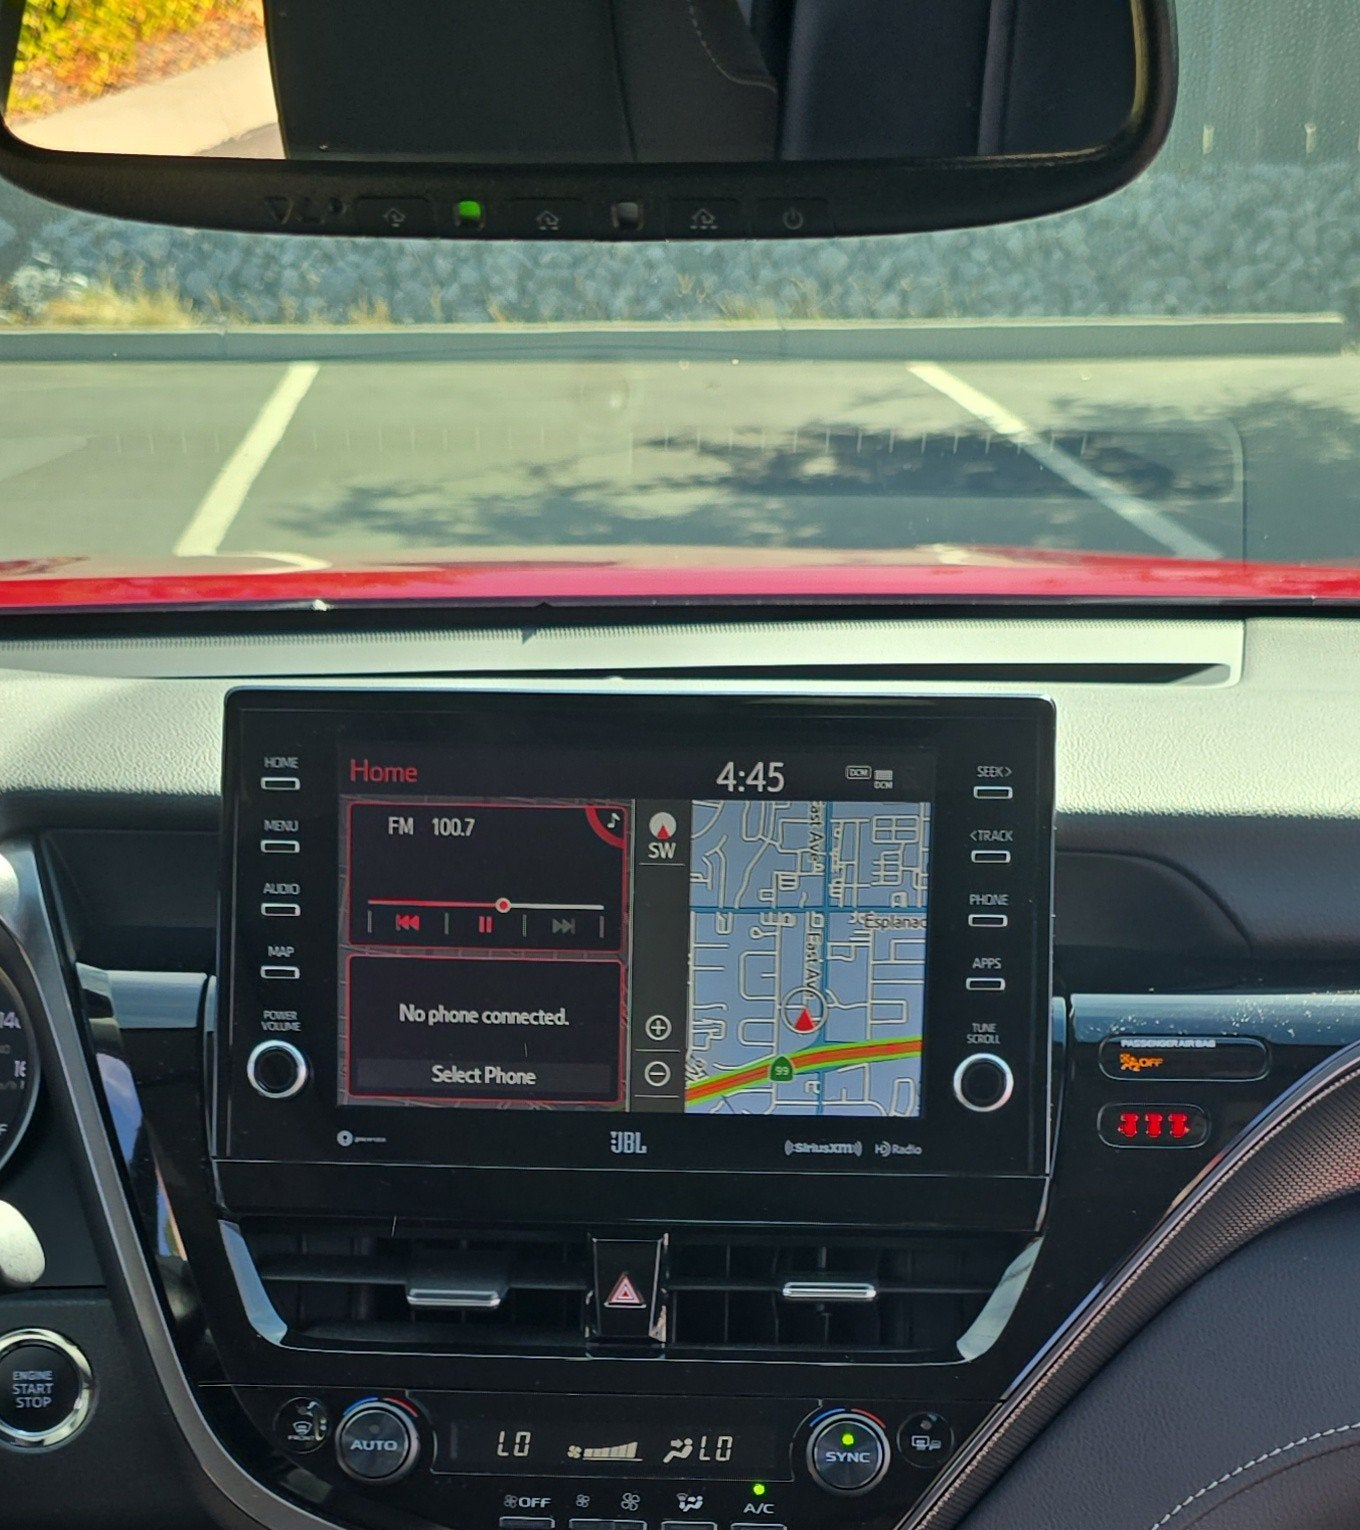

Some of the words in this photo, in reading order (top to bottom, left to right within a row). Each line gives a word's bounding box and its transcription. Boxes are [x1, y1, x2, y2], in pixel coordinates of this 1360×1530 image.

[263, 757, 299, 769] HOME
[350, 758, 418, 783] Home
[716, 761, 785, 793] 4:45
[263, 819, 299, 832] MENU
[388, 816, 414, 835] FM
[432, 817, 476, 837] 100.7
[648, 842, 676, 860] SW
[262, 883, 301, 895] AUDIO
[969, 894, 1009, 906] PHONE
[267, 946, 295, 957] MAP
[972, 957, 1002, 969] APPS
[263, 1010, 298, 1021] POWER
[399, 1003, 426, 1023] No
[428, 1004, 479, 1026] phone
[481, 1007, 570, 1026] connected.
[261, 1020, 301, 1032] VOLUME
[971, 1023, 996, 1034] TUNE
[966, 1033, 1000, 1045] SCROLL
[431, 1064, 483, 1084] Select
[484, 1066, 537, 1085] Phone
[775, 1066, 789, 1075] 99
[610, 1131, 647, 1154] JBL
[891, 1143, 923, 1155] Radio
[12, 1383, 54, 1395] START
[16, 1396, 52, 1408] STOP
[350, 1438, 398, 1451] AUTO
[825, 1451, 870, 1464] SYNC
[518, 1497, 552, 1508] OFF
[743, 1502, 775, 1515] A/C
